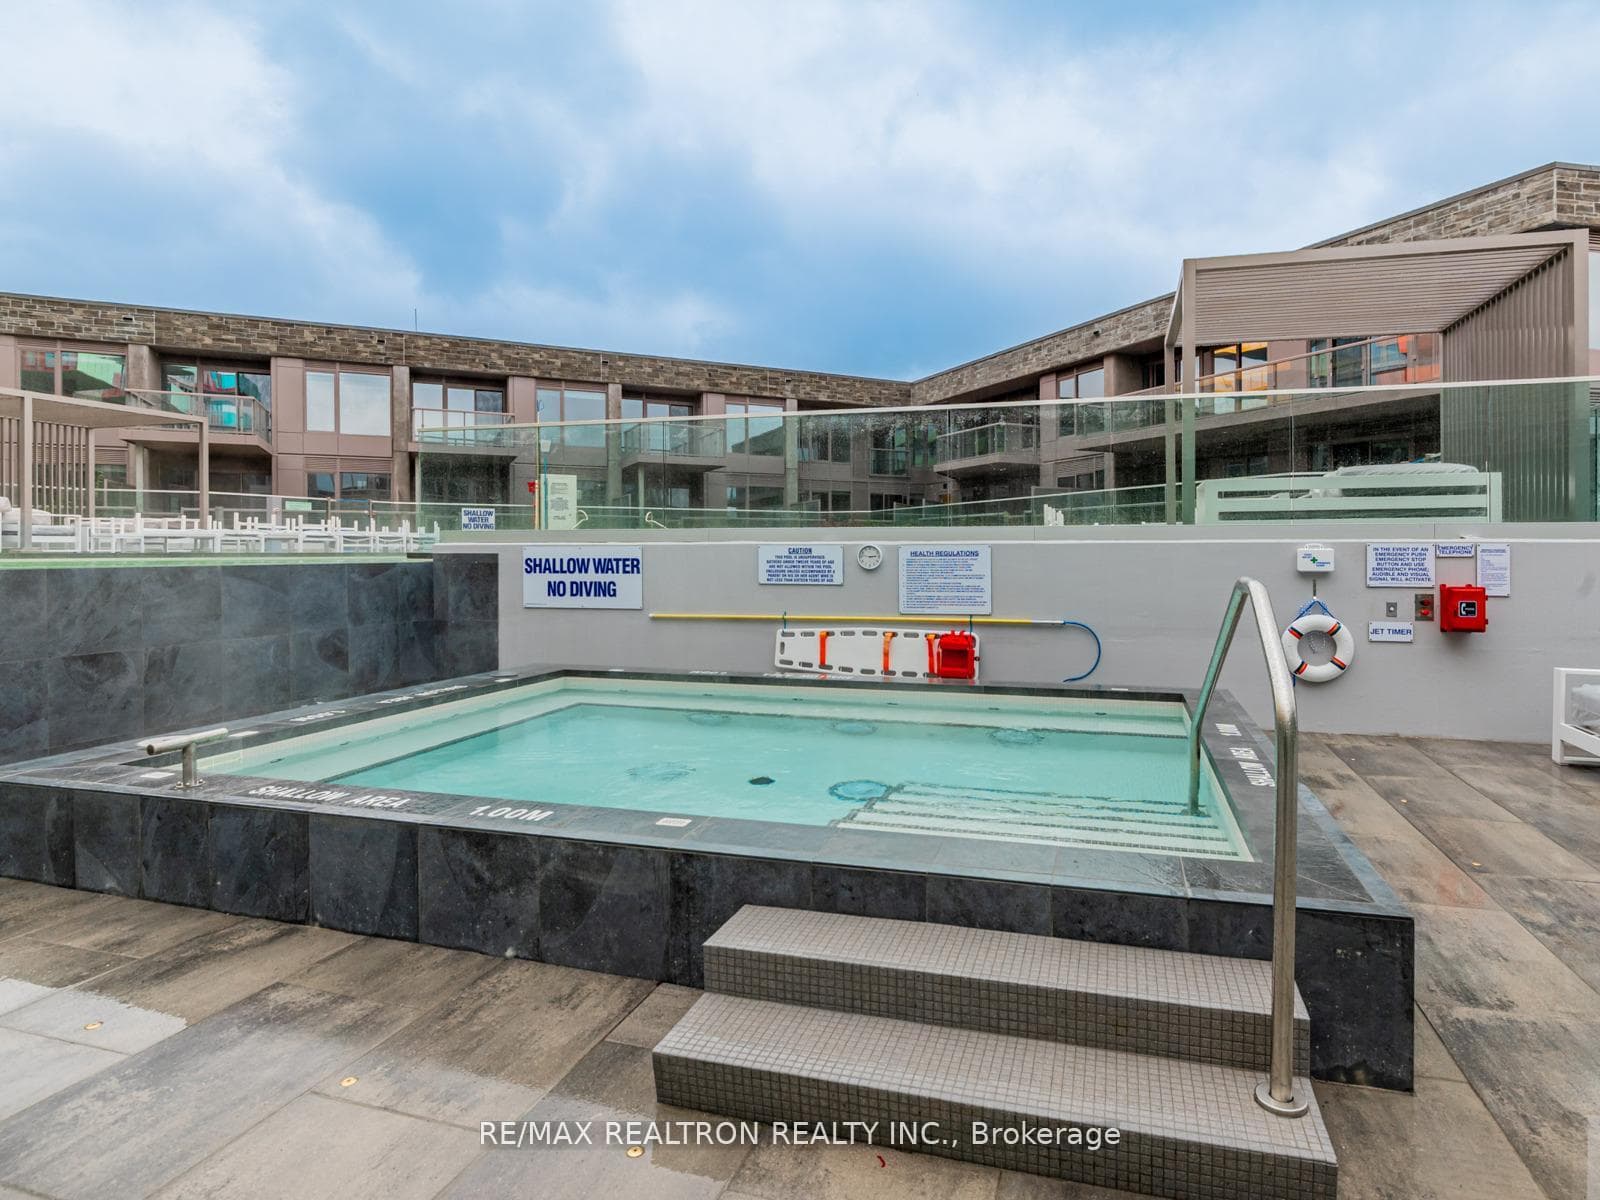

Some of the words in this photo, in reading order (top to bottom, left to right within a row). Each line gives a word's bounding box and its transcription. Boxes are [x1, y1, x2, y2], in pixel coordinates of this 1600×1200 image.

[524, 558, 591, 574] SHALLOW
[592, 558, 640, 574] WATER
[547, 580, 566, 598] NO
[570, 580, 617, 598] DIVING
[248, 786, 350, 802] SHALLOW
[345, 794, 411, 808] AREA
[469, 805, 554, 822] 1.00M
